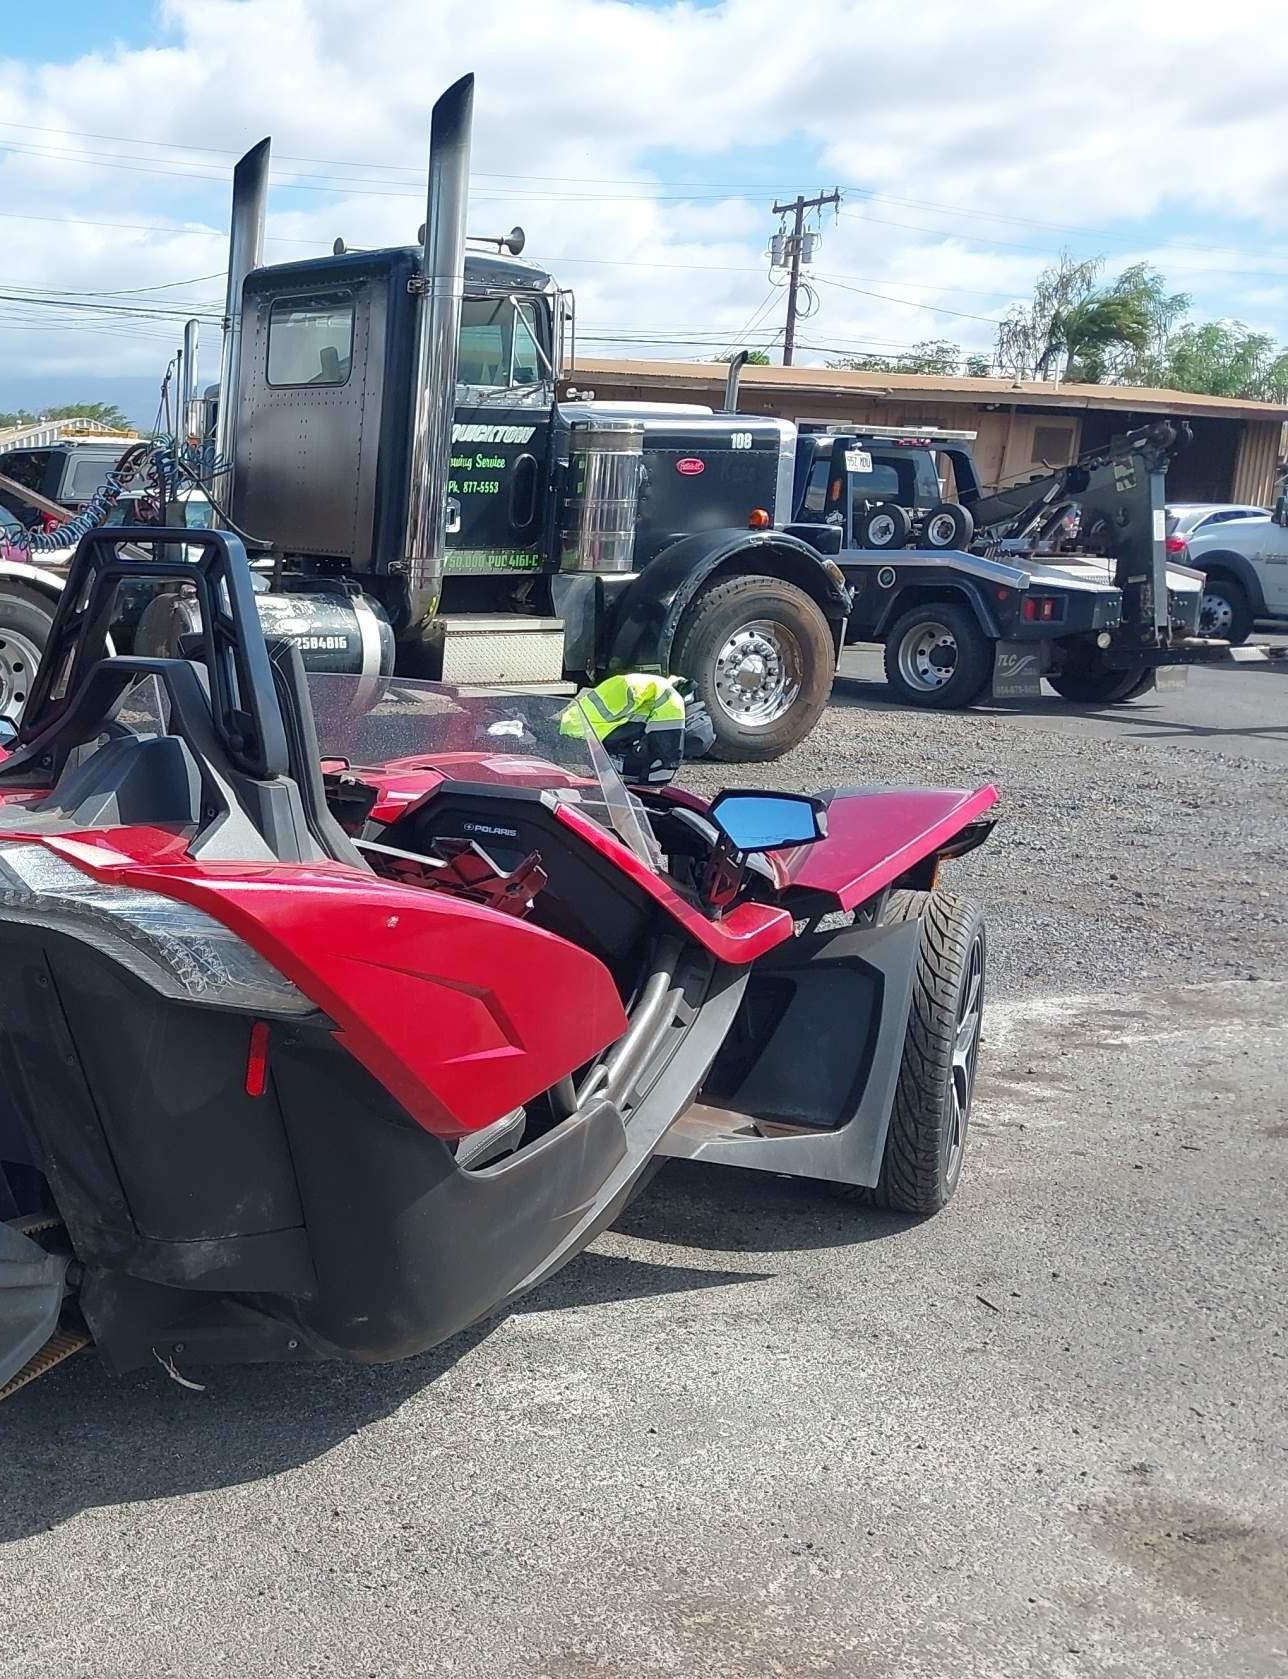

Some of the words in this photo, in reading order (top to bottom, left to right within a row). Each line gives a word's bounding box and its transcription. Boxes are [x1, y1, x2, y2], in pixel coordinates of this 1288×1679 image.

[730, 432, 752, 449] 108
[475, 453, 506, 469] Service
[462, 481, 499, 494] 877-5553
[487, 555, 508, 568] PUC
[508, 554, 539, 567] 4161-C
[998, 654, 1017, 667] TLC
[474, 824, 517, 837] POLARIS
